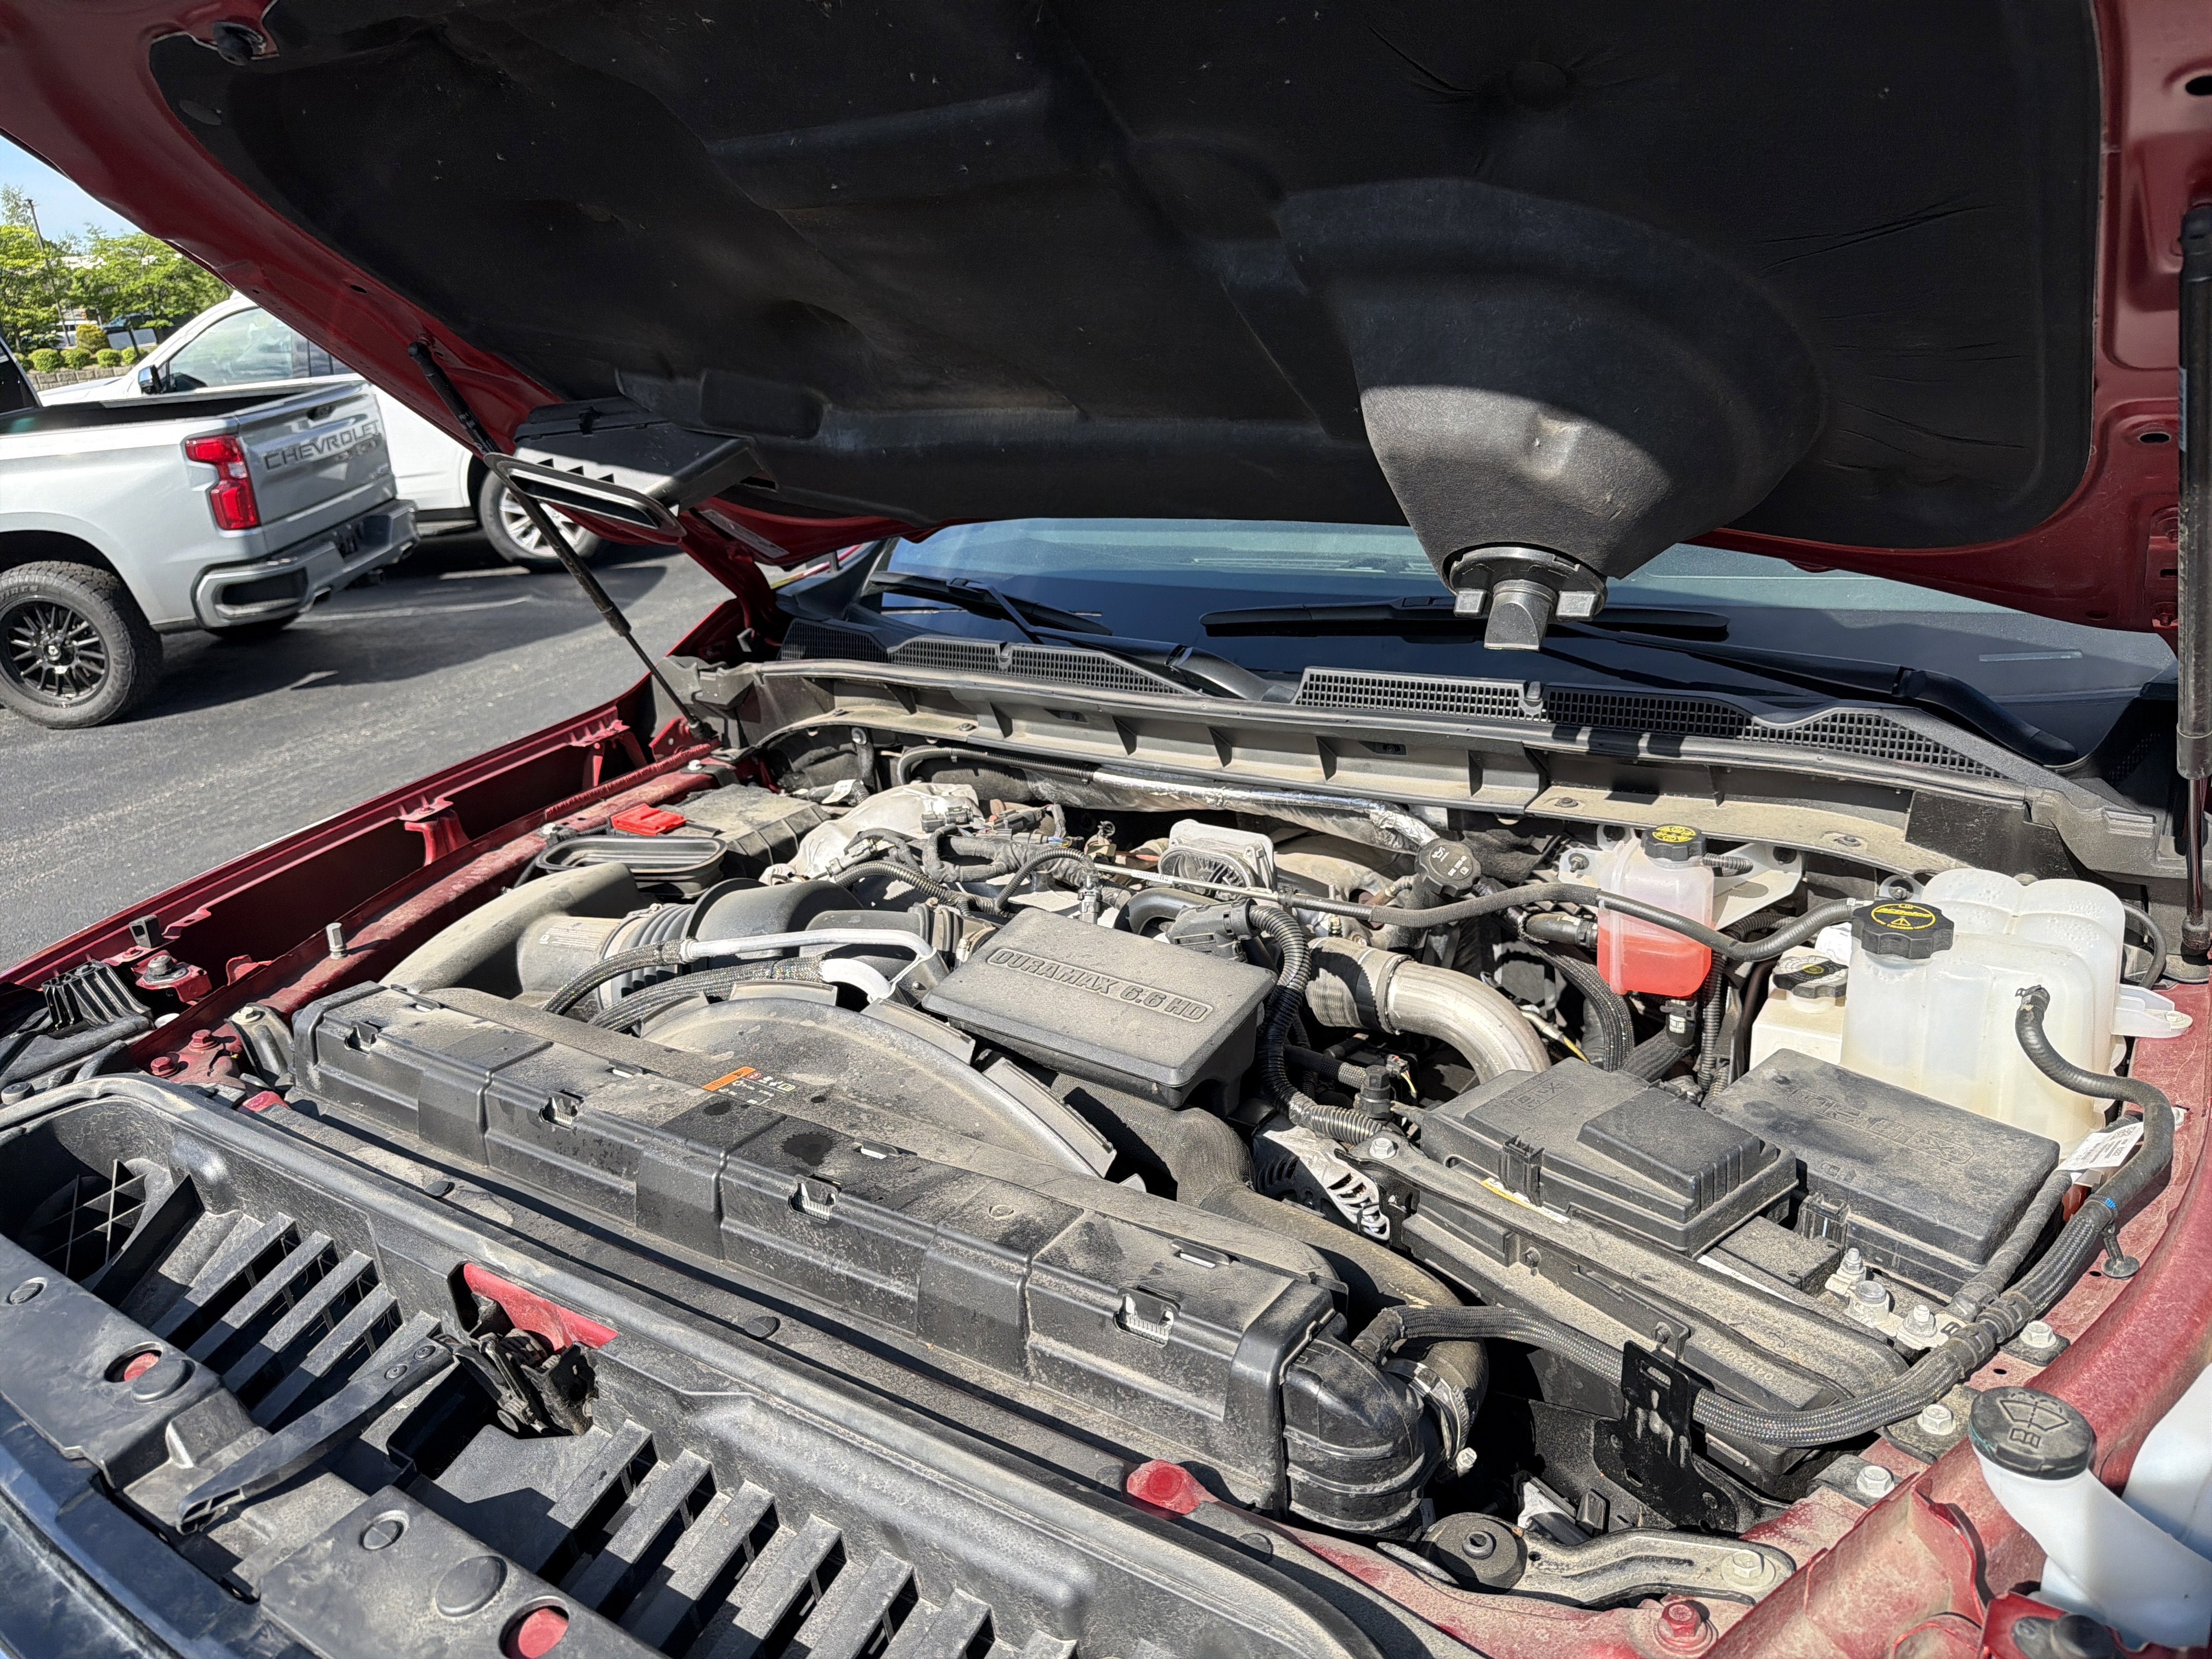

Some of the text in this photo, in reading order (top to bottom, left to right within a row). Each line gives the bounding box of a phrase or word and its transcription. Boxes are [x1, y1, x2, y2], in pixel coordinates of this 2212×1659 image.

[264, 420, 379, 470] CHEVROLET
[990, 950, 1207, 1020] DURAMAX 6.6 HD
